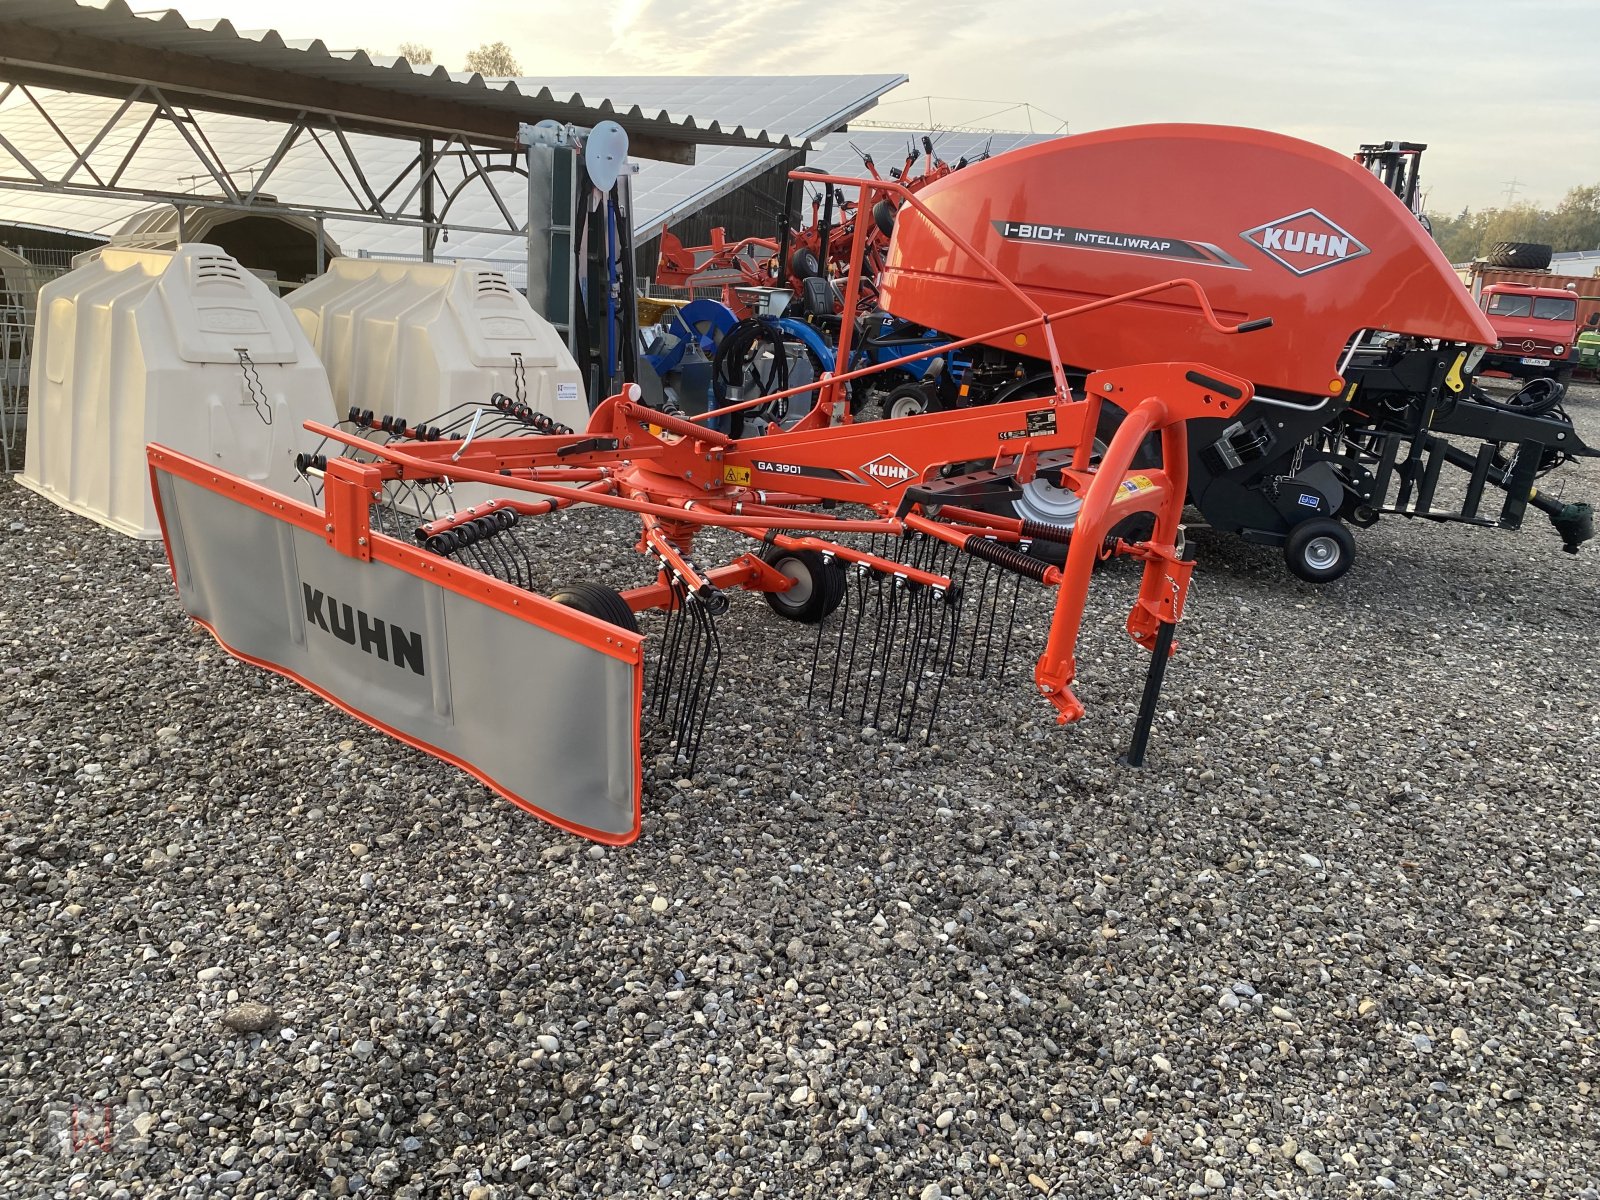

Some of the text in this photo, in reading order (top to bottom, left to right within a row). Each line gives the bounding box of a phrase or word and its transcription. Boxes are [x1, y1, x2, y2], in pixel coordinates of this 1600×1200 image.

[1004, 223, 1171, 251] I-BIO+ INTELLIWRAP
[1262, 227, 1349, 258] KUHN
[757, 461, 801, 475] GA 3901
[869, 463, 909, 479] KUHN
[303, 581, 425, 677] KUHN
